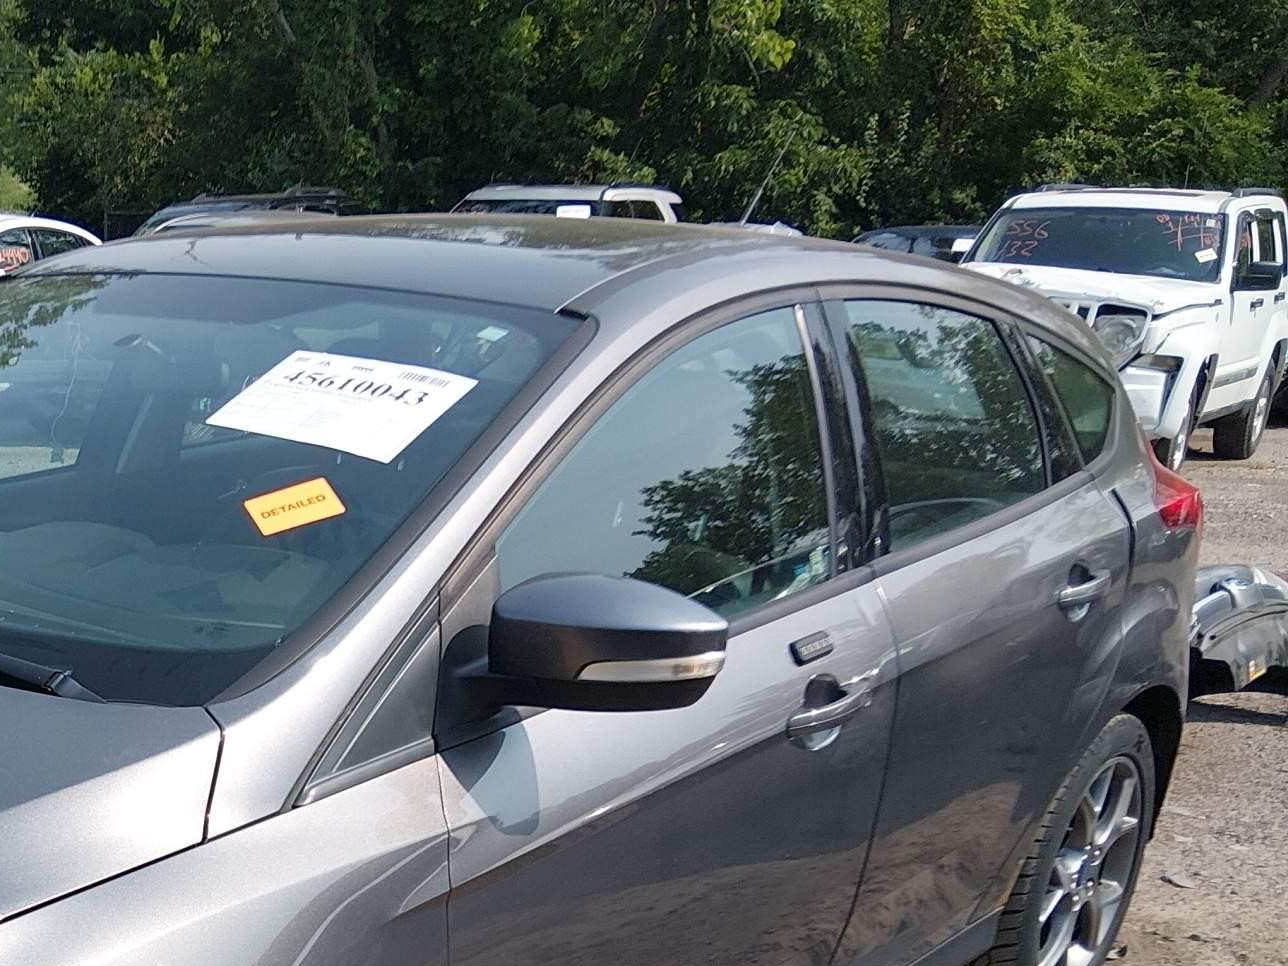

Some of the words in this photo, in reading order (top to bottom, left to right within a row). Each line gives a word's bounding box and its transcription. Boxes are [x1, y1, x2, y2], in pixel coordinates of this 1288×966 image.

[1006, 219, 1051, 239] 556
[284, 369, 429, 406] 45610043
[260, 494, 327, 520] DETAILED
